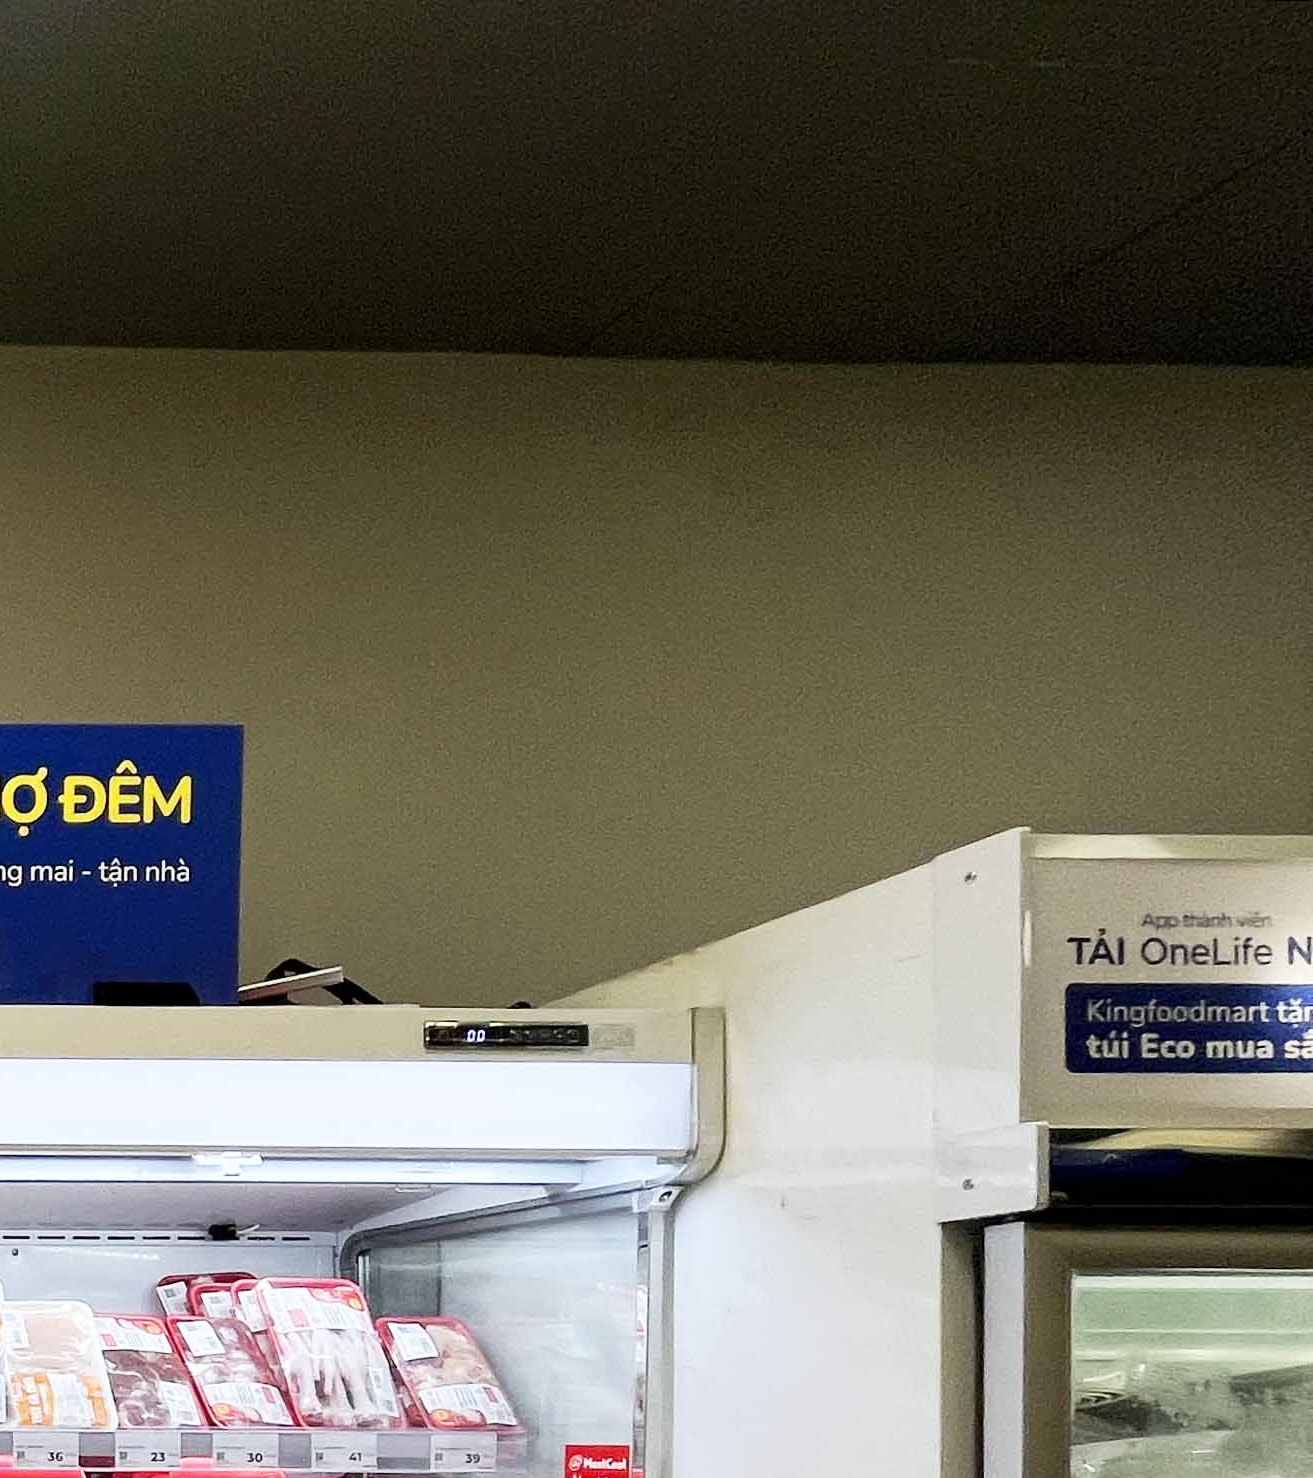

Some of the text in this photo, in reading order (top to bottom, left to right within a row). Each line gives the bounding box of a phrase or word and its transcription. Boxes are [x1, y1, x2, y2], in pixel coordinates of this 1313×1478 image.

[60, 761, 190, 823] ĐÊM
[31, 860, 73, 881] mai
[98, 858, 137, 887] tận
[146, 858, 189, 882] nhà
[1067, 928, 1124, 965] TẢI
[1141, 937, 1272, 966] OneLife
[1087, 998, 1269, 1027] Kingfoodmart
[1086, 1031, 1129, 1058] túi
[1141, 1033, 1195, 1058] Eco
[1207, 1040, 1274, 1058] mua
[47, 1451, 64, 1462] 36
[150, 1452, 166, 1463] 23
[349, 1453, 362, 1462] 41
